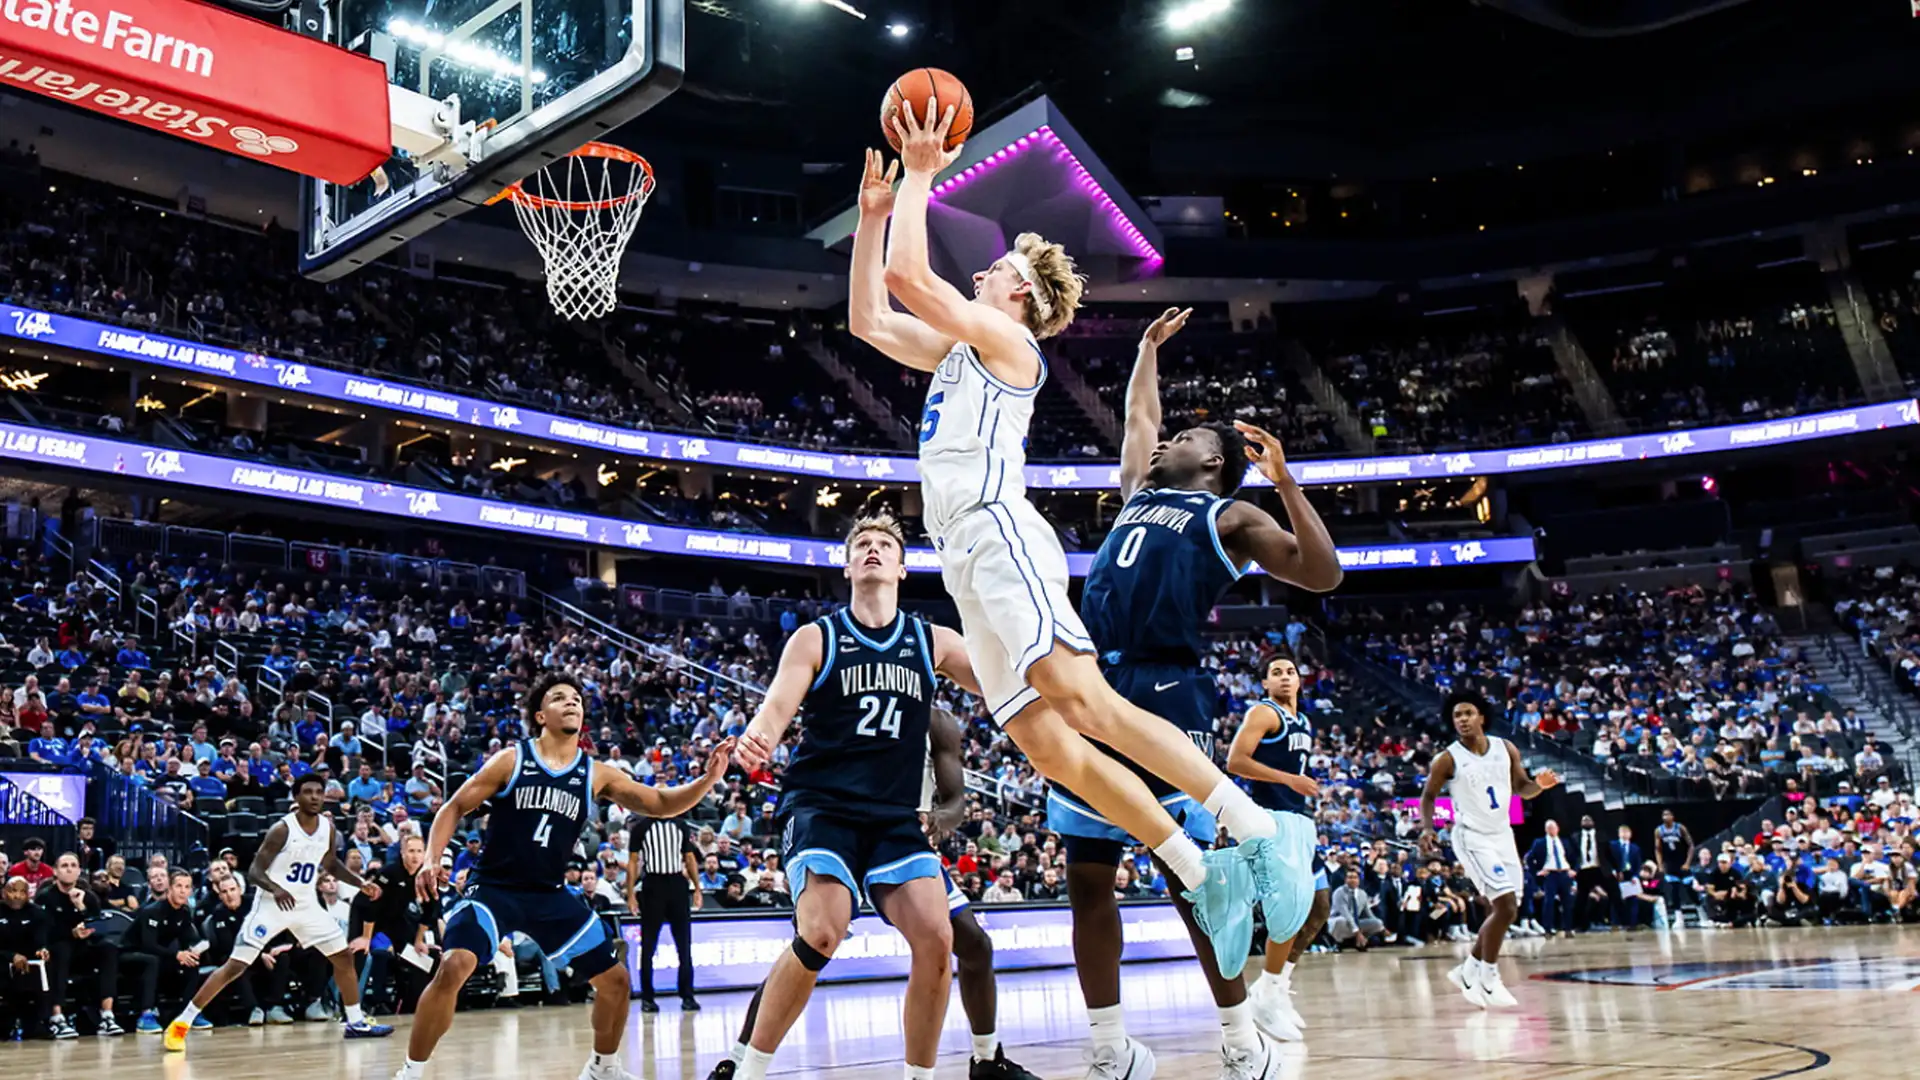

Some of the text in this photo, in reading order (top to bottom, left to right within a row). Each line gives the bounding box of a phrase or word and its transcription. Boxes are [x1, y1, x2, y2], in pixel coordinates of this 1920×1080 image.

[0, 0, 99, 44] tate
[168, 345, 194, 363] LAS
[1116, 526, 1147, 568] 0
[840, 662, 923, 702] VILLANOVA
[856, 695, 903, 740] 24
[514, 785, 581, 821] VILLANOVA
[1485, 785, 1500, 810] 1
[533, 813, 554, 848] 4
[286, 861, 316, 884] 30
